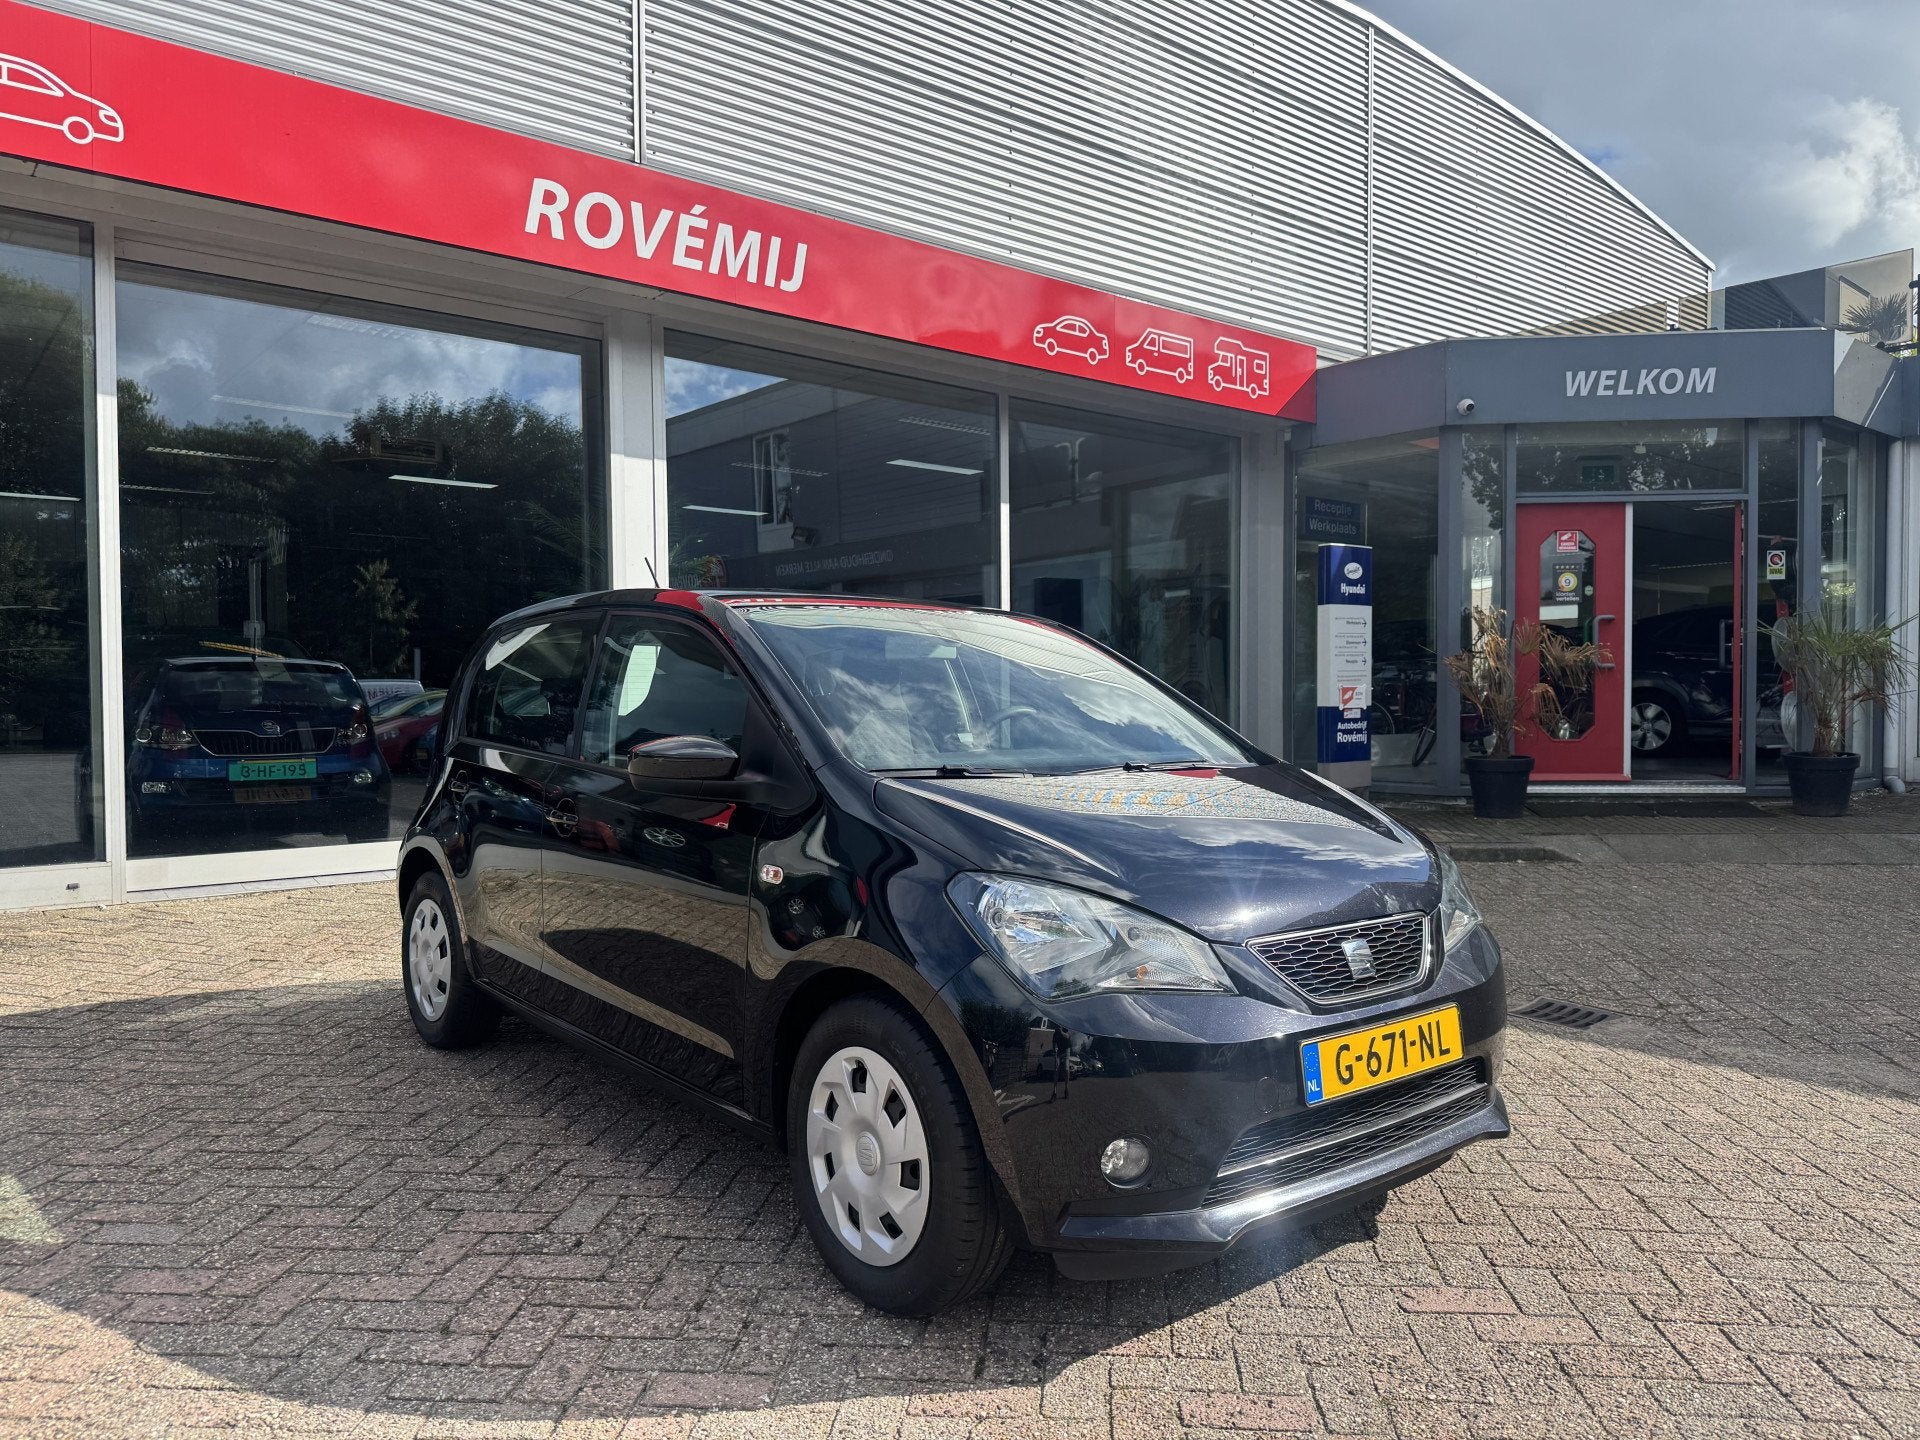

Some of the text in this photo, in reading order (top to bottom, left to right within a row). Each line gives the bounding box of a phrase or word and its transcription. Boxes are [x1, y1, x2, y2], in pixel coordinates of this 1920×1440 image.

[525, 177, 808, 292] ROVÉMIJ
[1565, 367, 1717, 397] WELKOM
[1314, 499, 1352, 516] Receptie
[1309, 518, 1357, 535] Werkplaats
[1341, 583, 1366, 596] Hyundai
[1564, 578, 1571, 587] 9
[1337, 721, 1367, 730] Autobedrijf
[1337, 731, 1367, 744] Rovémij
[1335, 1019, 1451, 1086] G-671-NL
[1308, 1079, 1320, 1093] NL
